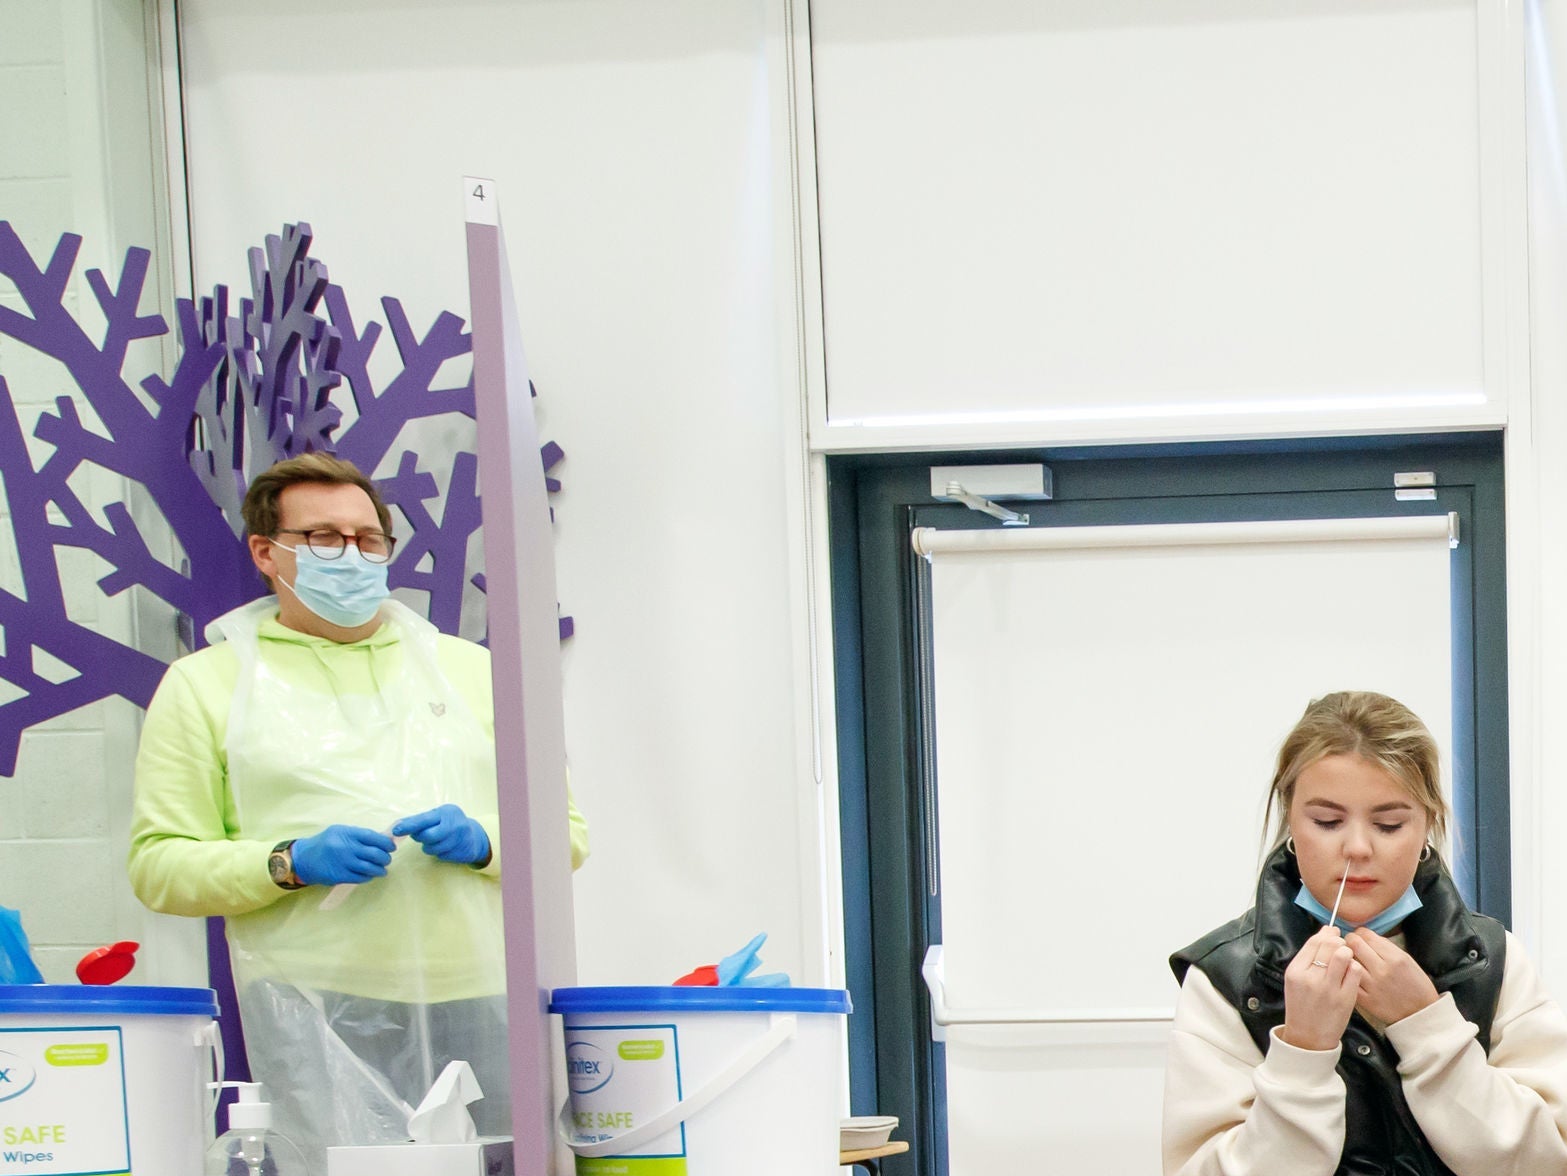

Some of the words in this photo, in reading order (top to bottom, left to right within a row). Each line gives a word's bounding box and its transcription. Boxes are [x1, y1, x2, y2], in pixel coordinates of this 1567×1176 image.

[472, 184, 486, 201] 4
[597, 1112, 633, 1129] SAFE
[3, 1125, 66, 1145] SAFE
[3, 1151, 54, 1164] Wipes
